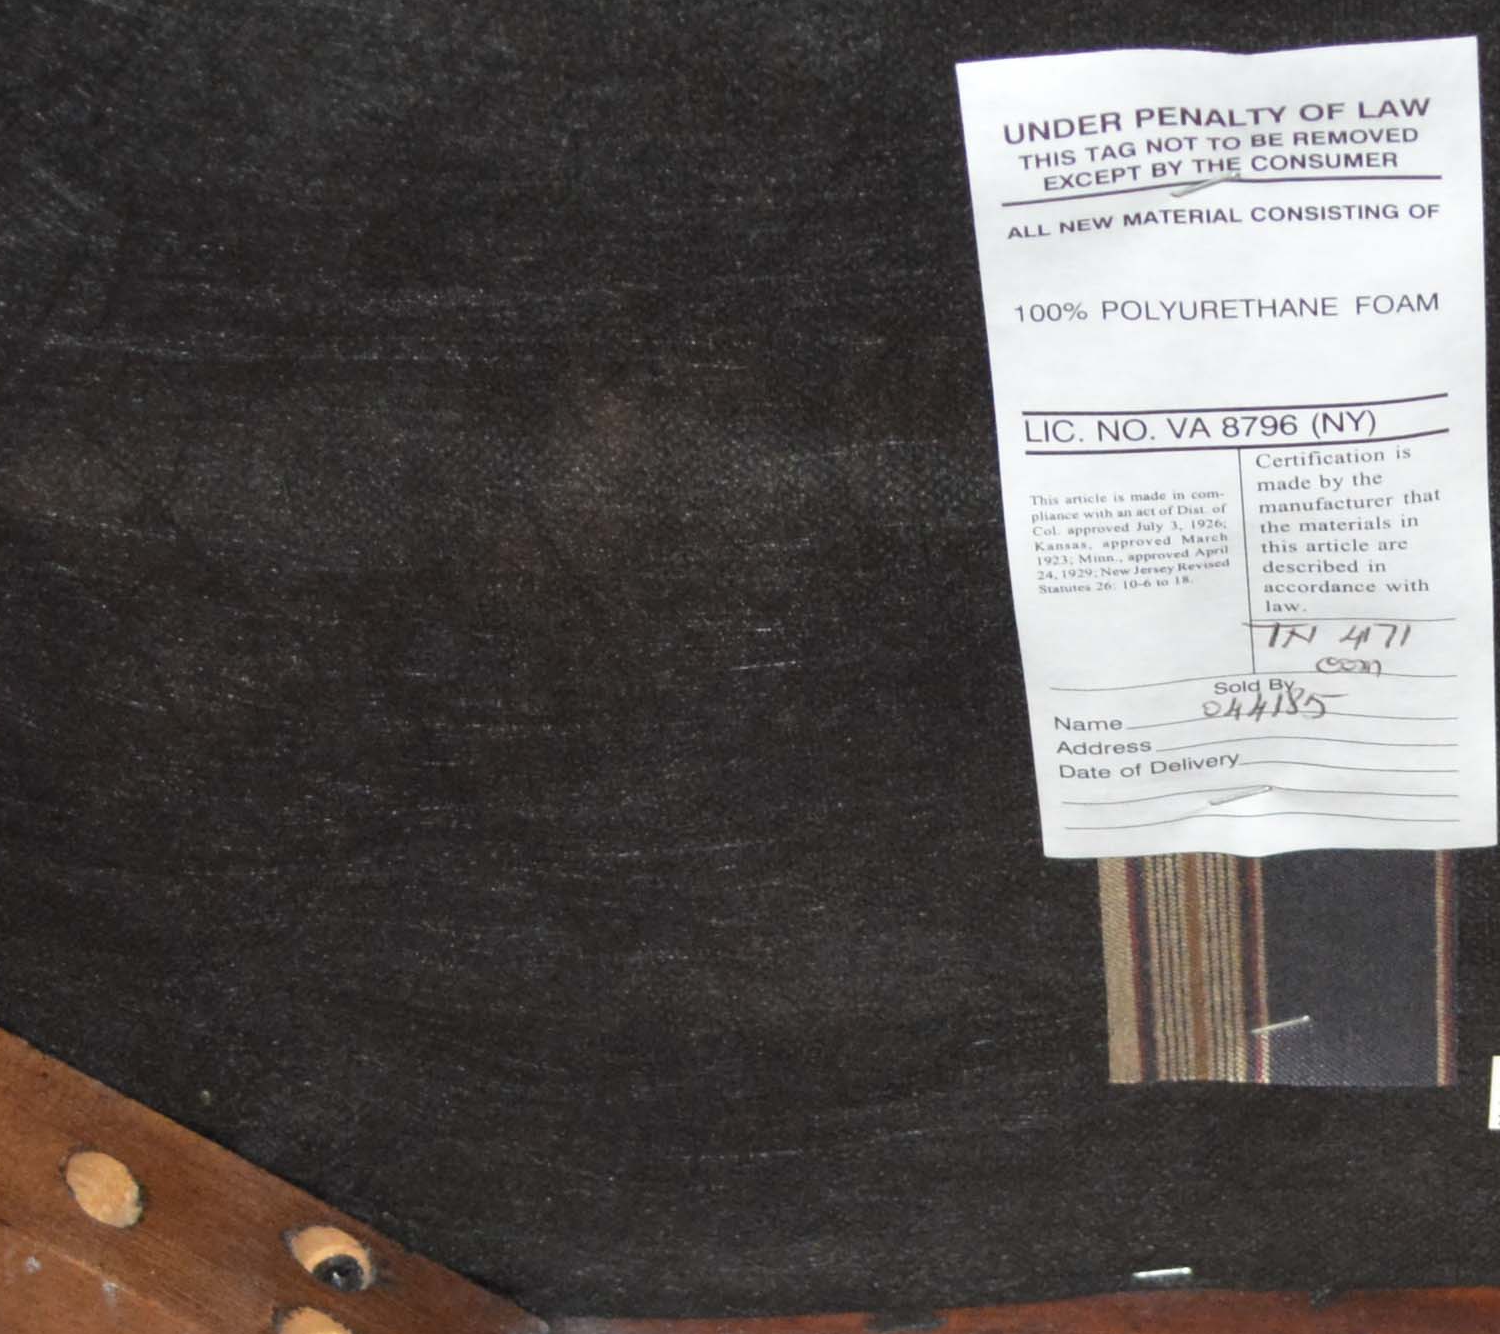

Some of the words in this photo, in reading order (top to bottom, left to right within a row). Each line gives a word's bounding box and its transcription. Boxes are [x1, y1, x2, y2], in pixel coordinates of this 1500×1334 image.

[1003, 112, 1122, 145] UNDER
[1135, 106, 1286, 128] PENALTY
[1299, 102, 1345, 122] OF
[1358, 97, 1431, 119] LAW
[1018, 150, 1076, 170] THIS
[1085, 142, 1136, 162] TAG
[1146, 136, 1199, 155] NOT
[1207, 134, 1241, 151] TO
[1251, 132, 1282, 148] BE
[1292, 127, 1418, 145] REMOVED
[1044, 166, 1139, 191] EXCEPT
[1151, 160, 1183, 178] BY
[1192, 157, 1241, 174] THE
[1251, 152, 1399, 171] CONSUMER
[1007, 224, 1050, 240] ALL
[1060, 216, 1113, 234] NEW
[1122, 206, 1241, 227] MATERIAL
[1250, 205, 1399, 222] CONSISTING
[1408, 203, 1441, 220] OF
[1014, 302, 1088, 323] 100%
[1102, 297, 1338, 321] POLYURETHANE
[1355, 293, 1440, 315] FOAM
[1024, 420, 1083, 443] LIC.
[1097, 418, 1155, 442] NO.
[1166, 417, 1211, 440] VA
[1222, 415, 1298, 438] 8796
[1311, 410, 1377, 439] (NY)
[1256, 449, 1385, 469] Certification
[1396, 445, 1411, 459] is
[1257, 476, 1311, 491] made
[1319, 474, 1343, 491] by
[1353, 472, 1383, 486] the
[1030, 496, 1059, 506] This
[1065, 494, 1106, 505] article
[1113, 493, 1124, 502] is
[1131, 491, 1166, 502] made
[1173, 491, 1185, 500] in
[1191, 491, 1224, 499] com-
[1259, 495, 1393, 513] manufacturer
[1404, 489, 1441, 505] that
[1031, 510, 1079, 523] pliance
[1084, 509, 1112, 519] with
[1117, 509, 1131, 517] an
[1136, 507, 1155, 516] act
[1159, 506, 1172, 515] of
[1212, 504, 1226, 513] of
[1032, 526, 1060, 536] Col.
[1067, 523, 1129, 536] approved
[1136, 520, 1163, 533] July
[1260, 521, 1290, 533] the
[1299, 517, 1391, 532] materials
[1401, 514, 1418, 528] in
[1103, 536, 1171, 549] approved
[1182, 534, 1228, 544] March
[1261, 540, 1297, 553] this
[1306, 539, 1369, 552] article
[1378, 539, 1408, 551] are
[1128, 549, 1188, 562] approved
[1195, 546, 1228, 558] April
[1101, 567, 1130, 576] New
[1134, 563, 1173, 575] Jersey
[1177, 559, 1230, 571] Revised
[1262, 560, 1358, 574] described
[1368, 561, 1386, 572] in
[1038, 582, 1090, 594] Statutes
[1156, 578, 1168, 587] to
[1264, 580, 1376, 593] accordance
[1386, 579, 1429, 592] with
[1265, 601, 1307, 612] law.
[1214, 680, 1260, 695] Sold
[1269, 678, 1294, 692] By
[1054, 716, 1122, 731] Name
[1057, 738, 1152, 754] Address
[1059, 763, 1111, 779] Date
[1120, 760, 1141, 776] of
[1150, 751, 1240, 774] Delivery
